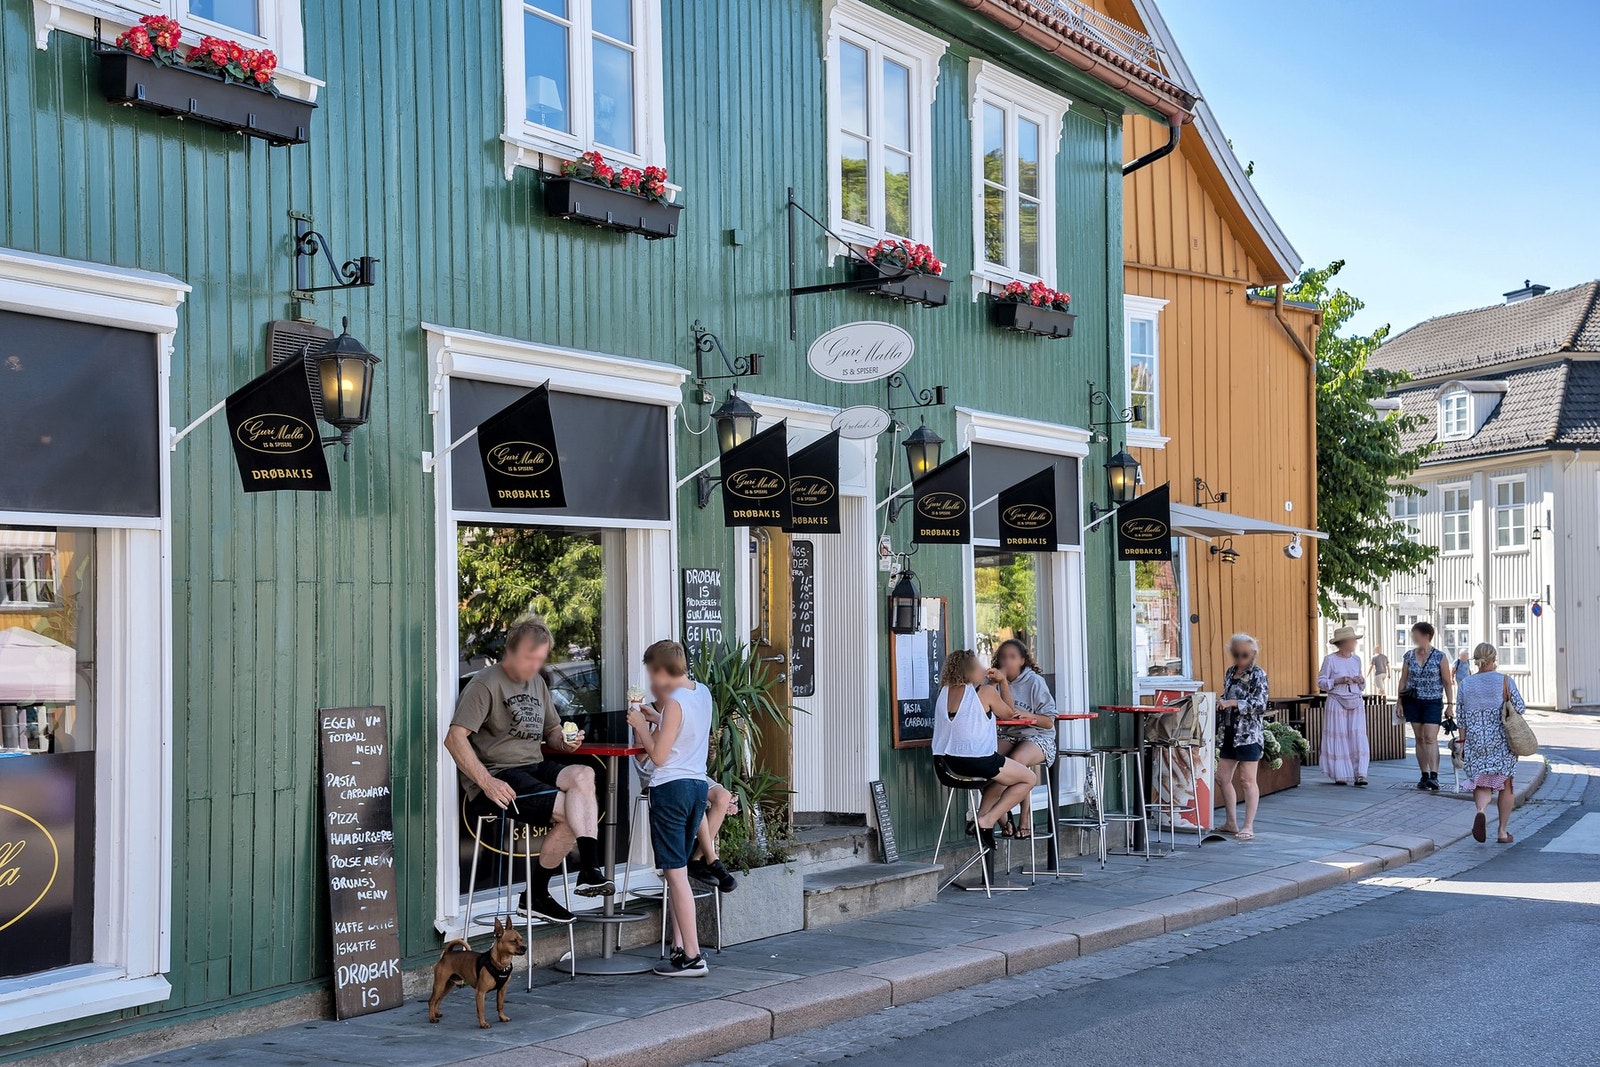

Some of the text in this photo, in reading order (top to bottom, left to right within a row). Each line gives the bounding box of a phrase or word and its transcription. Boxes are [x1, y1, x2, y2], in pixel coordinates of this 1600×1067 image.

[823, 337, 904, 366] Guri Malla
[856, 367, 879, 375] SPISERI
[245, 420, 304, 441] Guri Malla
[494, 446, 545, 465] Guri Malla
[251, 468, 313, 480] DRØBAK IS
[733, 473, 779, 489] Guri Malla
[497, 489, 551, 499] DRØBAK IS
[802, 483, 828, 496] Malla
[733, 510, 781, 518] DRØBAK IS
[792, 516, 829, 525] RØBAK IS
[920, 528, 961, 537] DRØBAK IS
[1006, 537, 1048, 545] DRØBAK IS
[699, 586, 710, 598] IS
[903, 702, 922, 715] PASTA
[323, 717, 356, 729] EGEN
[356, 744, 383, 756] MENY
[326, 772, 357, 788] PASTA
[340, 786, 390, 800] CARBONARA
[328, 812, 360, 825] PIZZA
[357, 889, 388, 900] MENY
[334, 921, 364, 935] KAFFE
[336, 939, 377, 956] ISKAFFE
[337, 958, 400, 989] DRØBAK
